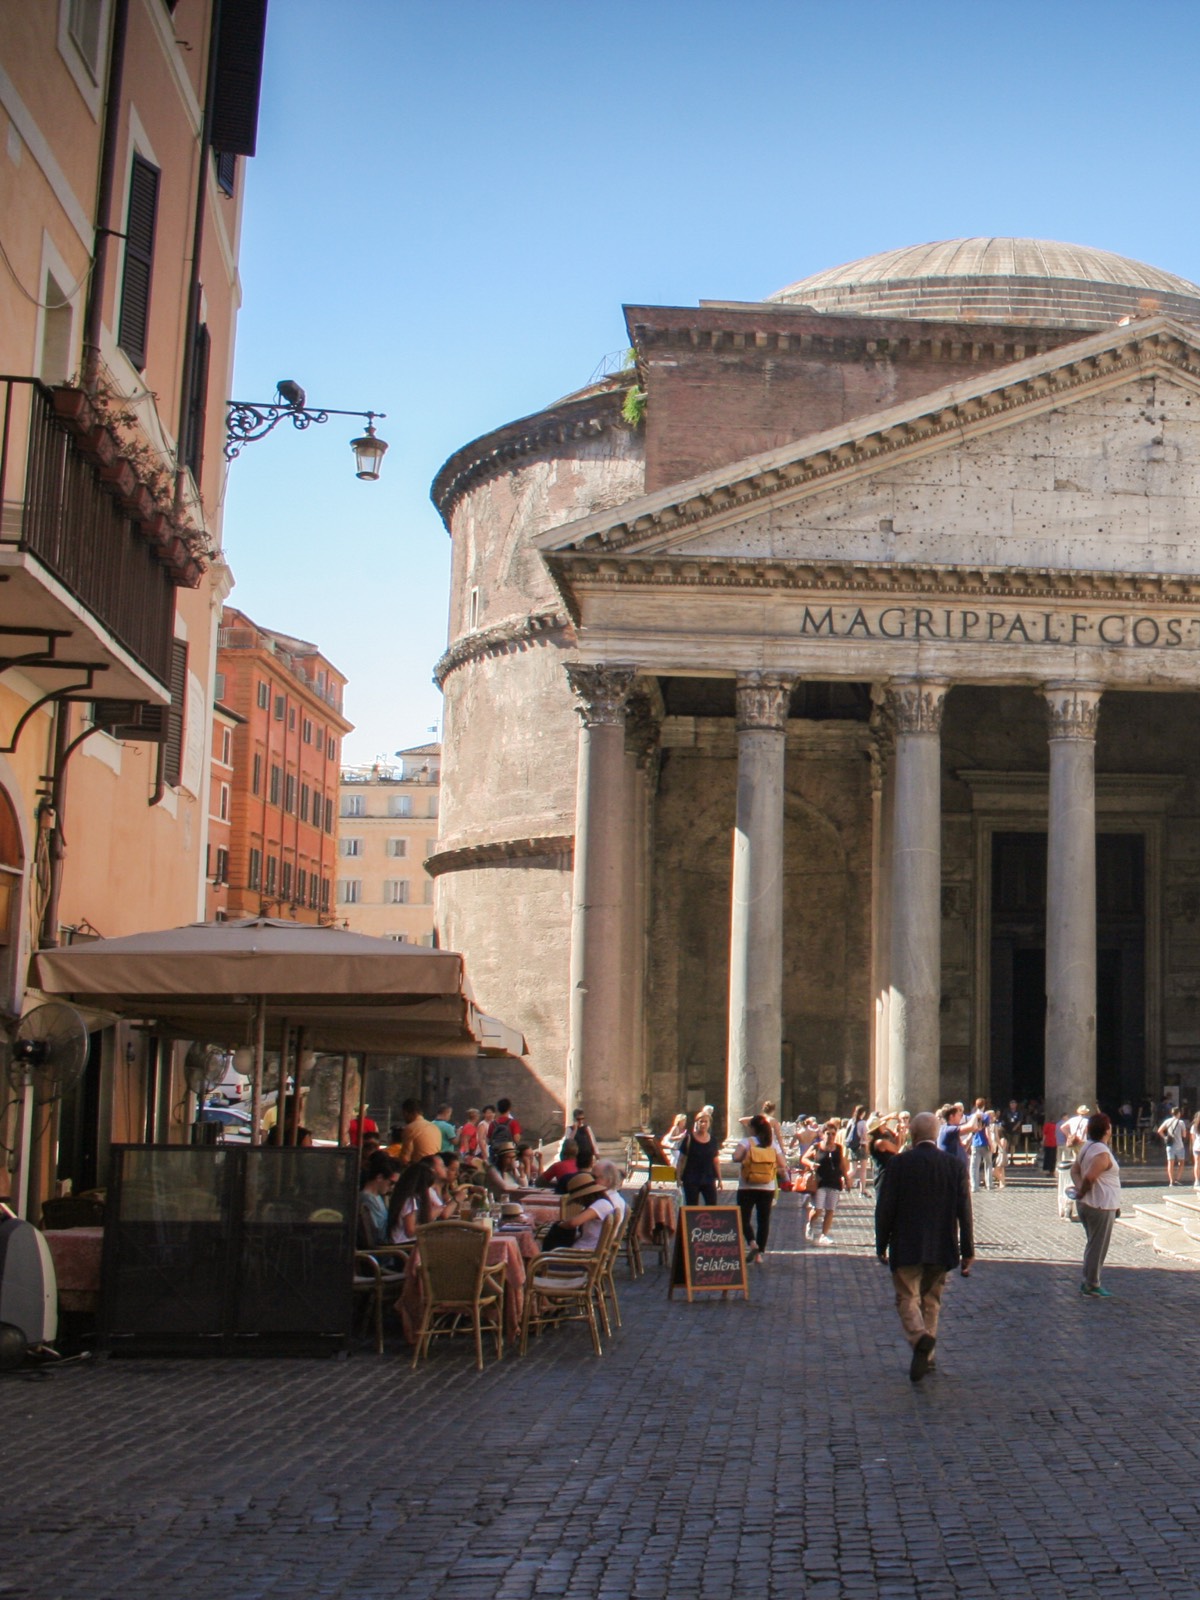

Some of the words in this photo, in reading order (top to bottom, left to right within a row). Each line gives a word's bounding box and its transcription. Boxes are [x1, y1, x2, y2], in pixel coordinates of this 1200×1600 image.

[845, 607, 1034, 643] AGRIPPA
[1098, 615, 1183, 648] COS
[695, 1212, 728, 1228] Bar
[691, 1227, 737, 1243] Ristorante
[695, 1256, 740, 1272] Gelateria
